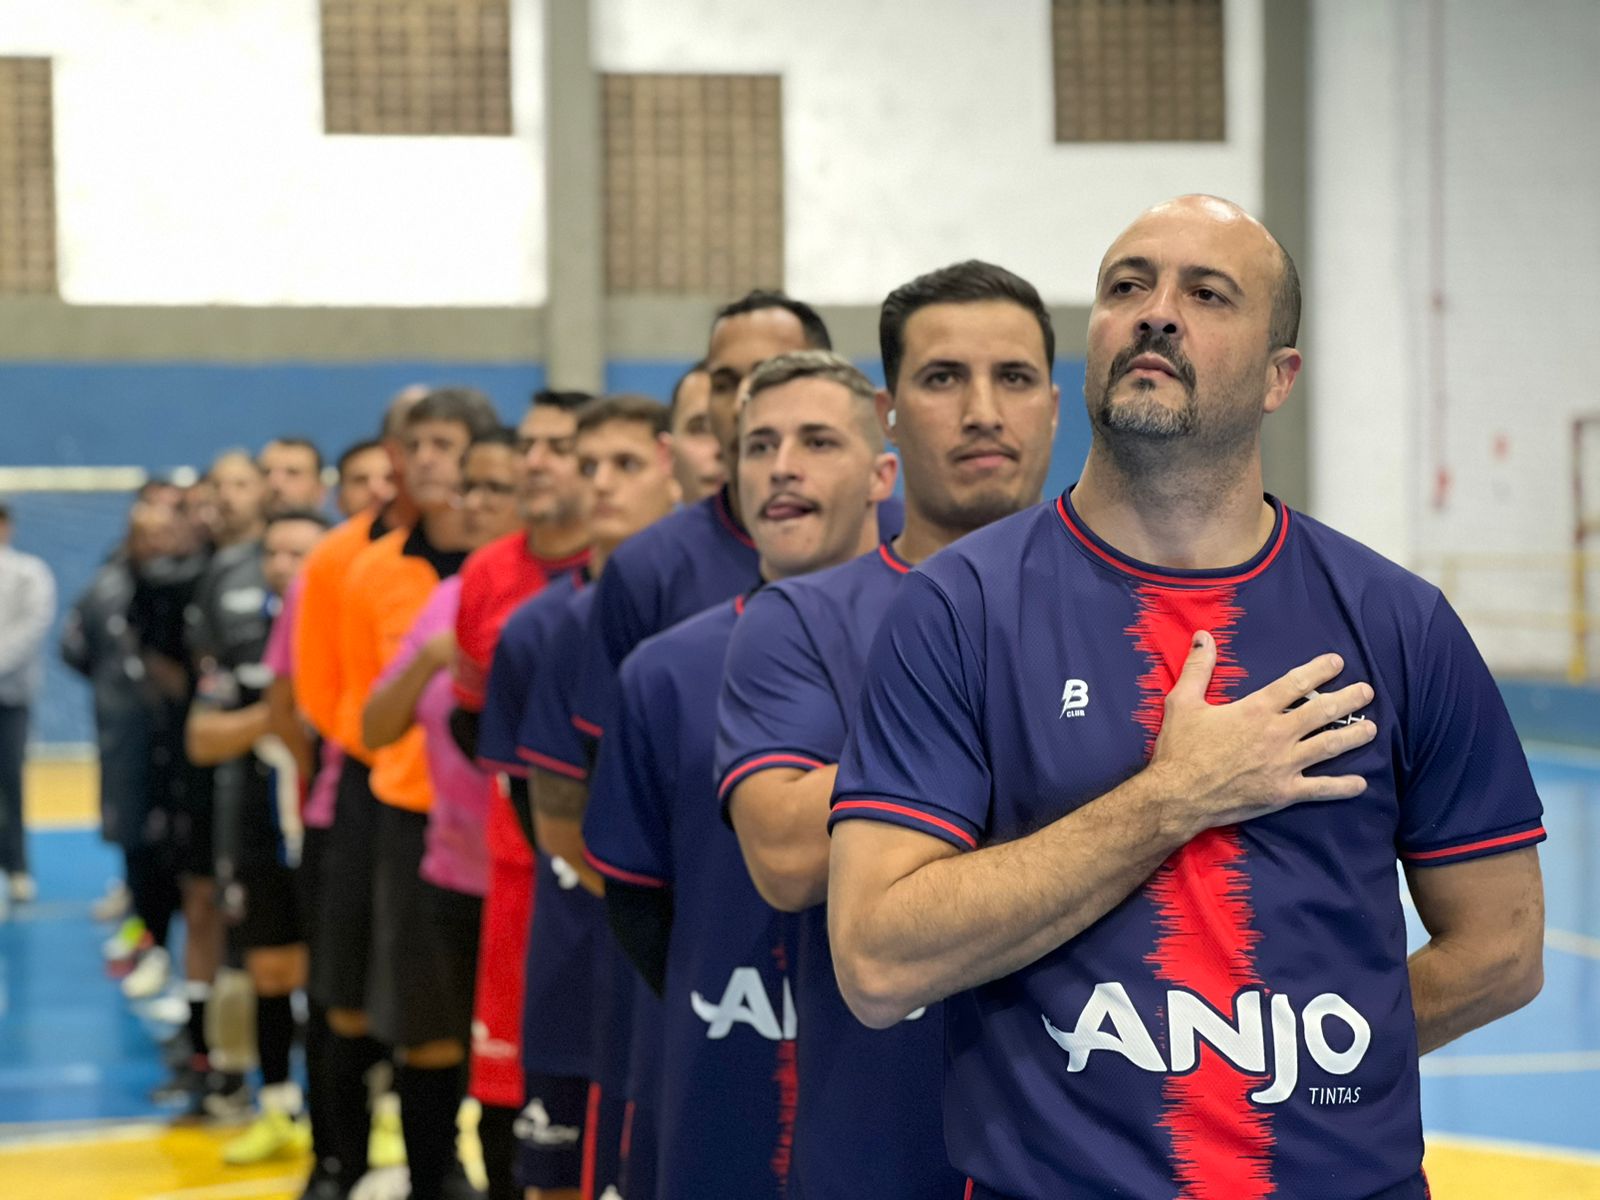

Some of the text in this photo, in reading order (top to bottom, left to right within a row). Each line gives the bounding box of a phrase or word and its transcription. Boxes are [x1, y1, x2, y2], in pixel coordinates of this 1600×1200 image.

[1066, 709, 1085, 718] CLUB
[1042, 981, 1371, 1105] ANJO
[1308, 1086, 1362, 1105] TINTAS
